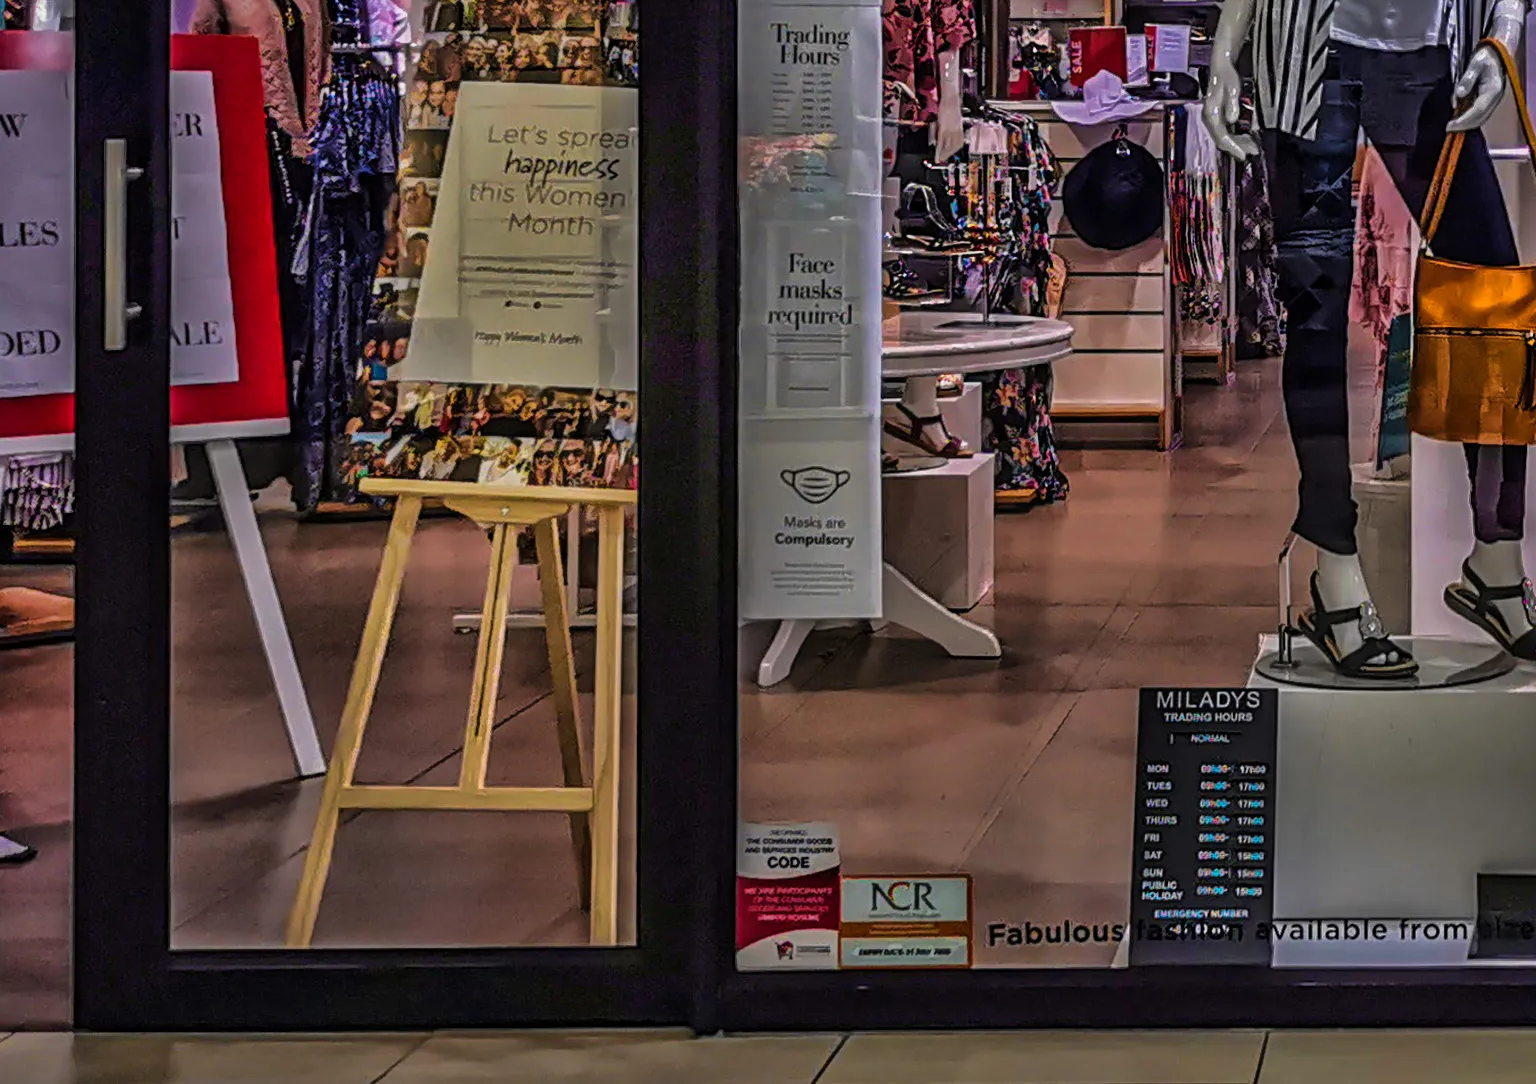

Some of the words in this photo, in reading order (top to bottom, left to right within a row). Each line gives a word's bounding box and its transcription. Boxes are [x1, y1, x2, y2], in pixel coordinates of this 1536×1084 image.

[770, 22, 850, 51] Trading
[781, 45, 840, 66] Hours
[1071, 40, 1083, 74] SALE
[488, 124, 548, 147] Let's
[504, 148, 620, 187] happiness
[469, 183, 515, 203] this
[508, 213, 593, 236] Month
[789, 252, 835, 274] Face
[778, 279, 843, 300] masks
[767, 304, 853, 330] required
[784, 516, 822, 529] Masks
[825, 519, 846, 529] are
[774, 533, 855, 548] Compulsory
[1156, 691, 1261, 709] MILADYS
[1164, 712, 1212, 722] TRADING
[1214, 712, 1253, 722] HOURS
[1190, 734, 1231, 744] NORMAL
[1146, 765, 1169, 774] MON
[1146, 781, 1172, 790] TUES
[1145, 799, 1169, 807] WED
[1144, 816, 1178, 825] THURS
[1144, 833, 1160, 843] FRI
[767, 856, 811, 869] CODE
[1143, 851, 1162, 860] SAT
[1143, 868, 1164, 878] SUN
[1142, 881, 1177, 890] PUBLIC
[870, 881, 937, 912] NCR
[1141, 891, 1184, 900] HOLIDAY
[1154, 909, 1209, 918] EMERGENCY
[1210, 909, 1249, 918] NUMBER
[988, 919, 1123, 947] Fabulous
[1255, 918, 1388, 942] available
[1398, 917, 1468, 941] from
